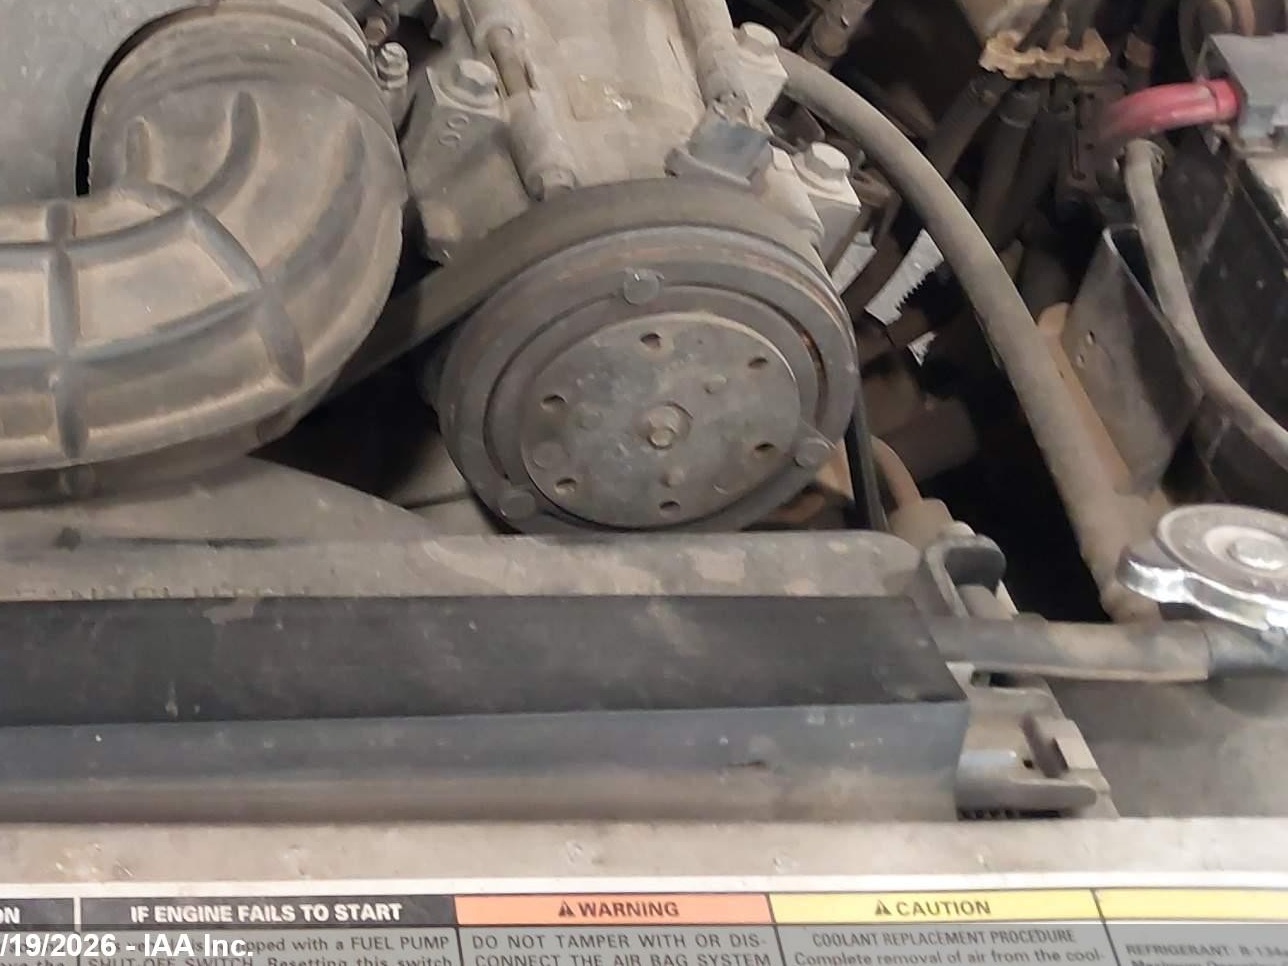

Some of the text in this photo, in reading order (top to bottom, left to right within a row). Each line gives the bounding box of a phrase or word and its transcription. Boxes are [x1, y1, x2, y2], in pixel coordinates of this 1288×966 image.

[130, 903, 403, 924] IF ENGINE FAILS TO START
[578, 901, 679, 917] WARNING
[896, 900, 992, 916] CAUTION
[292, 937, 328, 951] with
[335, 940, 344, 951] a
[350, 936, 394, 950] FUEL
[400, 936, 450, 950] PUMP
[472, 935, 498, 949] DO
[507, 935, 545, 949] NOT
[555, 934, 630, 949] TAMPER
[638, 934, 686, 948] WITH
[695, 934, 721, 948] OR
[812, 929, 1076, 947] COOLANT REPLACEMENT PROCEDURE
[794, 951, 872, 966] Complete
[876, 951, 942, 965] removal
[946, 950, 962, 964] of
[967, 950, 986, 963] air
[991, 950, 1030, 963] from
[1034, 949, 1061, 962] the
[1125, 944, 1231, 956] REFRIGERANT
[475, 953, 772, 966] CONNECT THE AIR BAG SYSTEM
